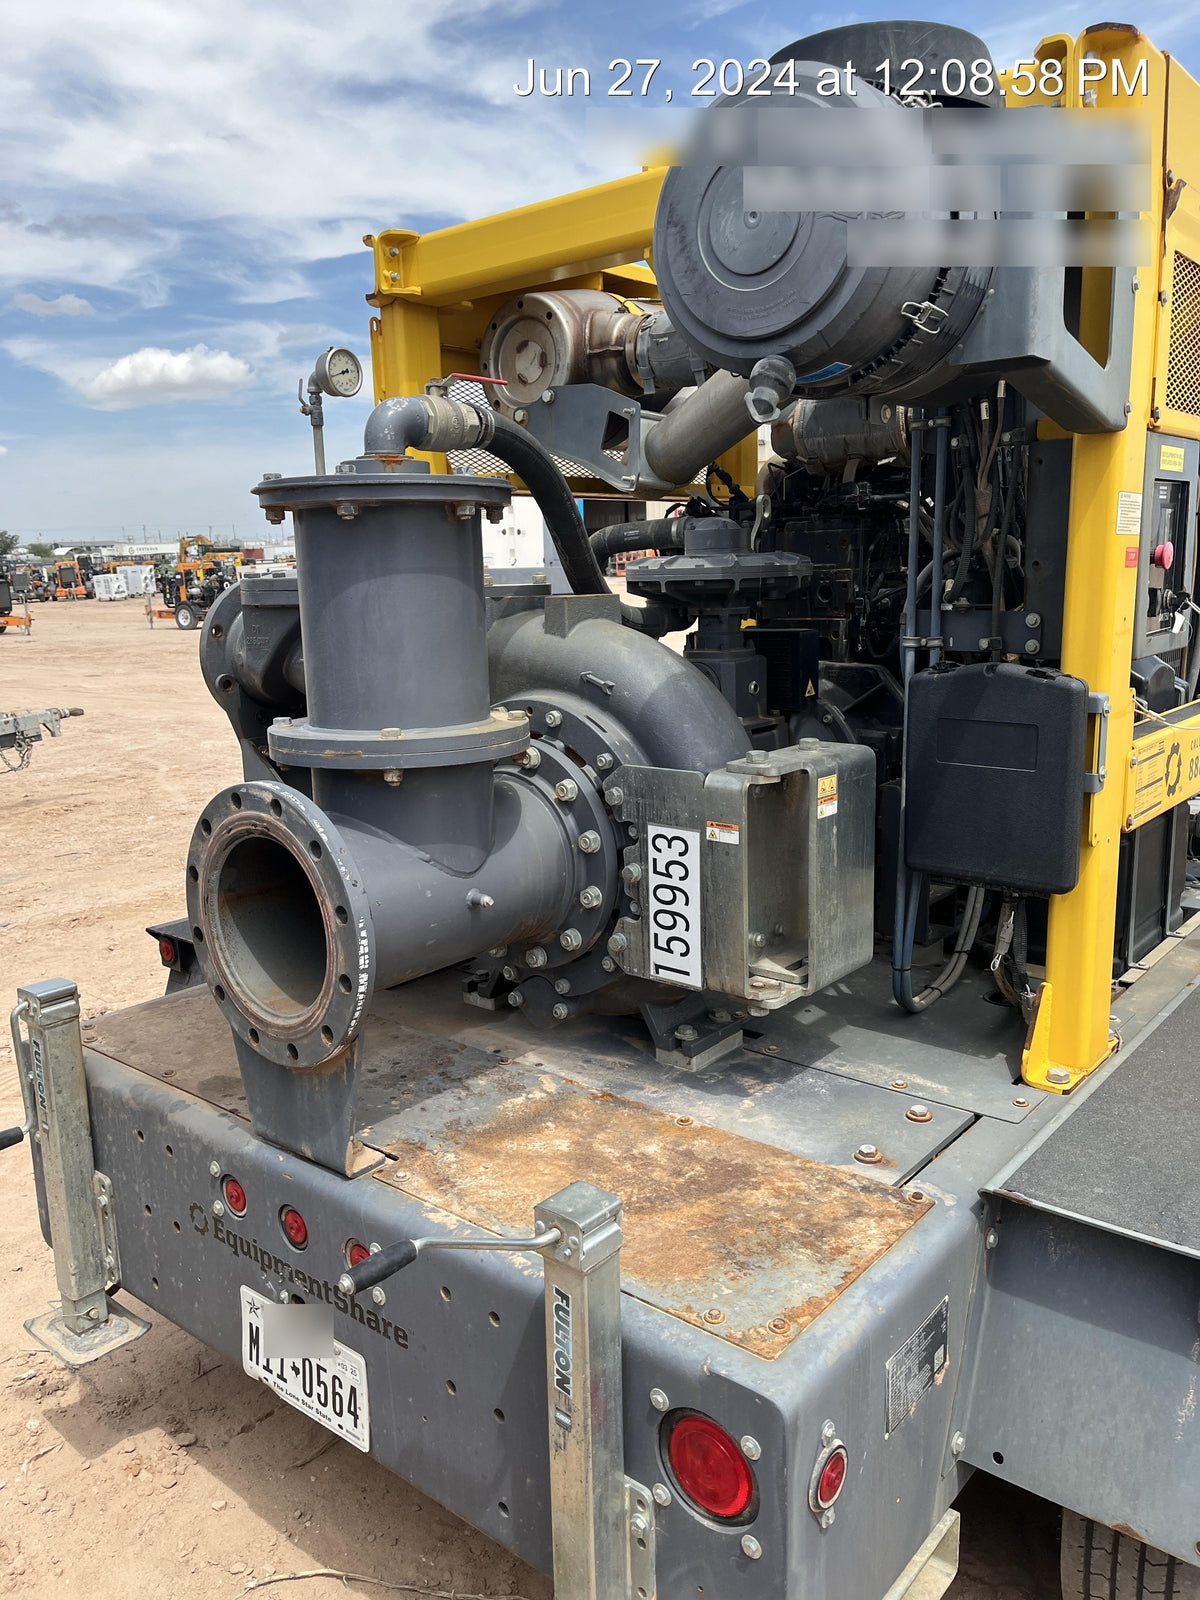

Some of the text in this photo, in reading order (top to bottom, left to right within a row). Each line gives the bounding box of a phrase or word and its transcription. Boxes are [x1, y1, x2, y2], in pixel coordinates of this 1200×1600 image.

[1189, 755, 1200, 781] 88
[651, 833, 690, 976] 159953
[33, 1039, 46, 1110] FULTON
[212, 1215, 409, 1349] EquipmentShare
[553, 1285, 572, 1399] FULTON
[272, 1381, 332, 1422] The Lone Star State
